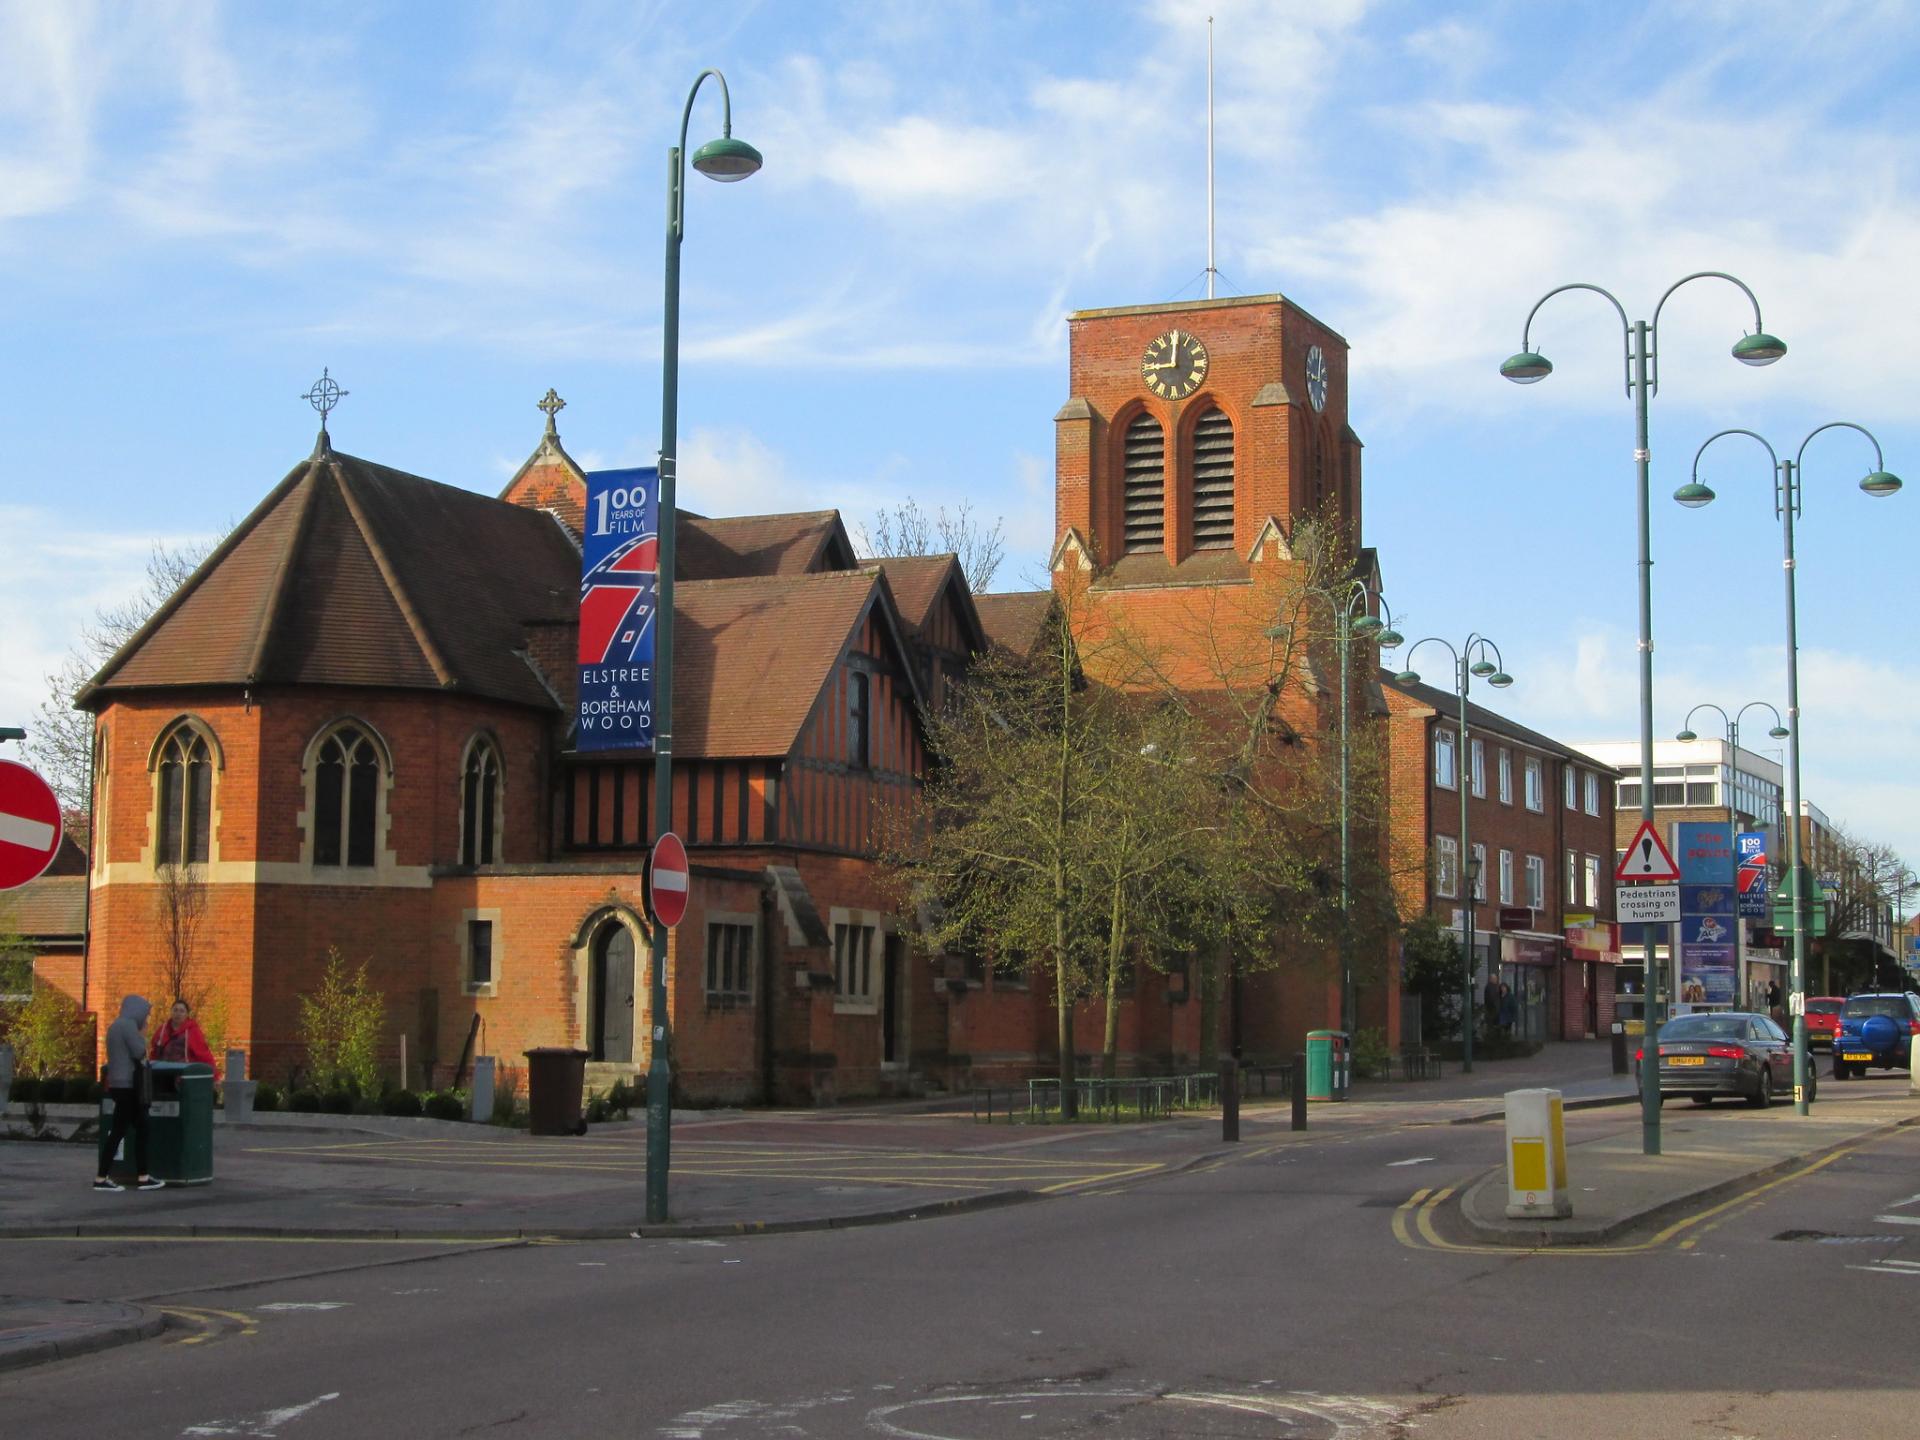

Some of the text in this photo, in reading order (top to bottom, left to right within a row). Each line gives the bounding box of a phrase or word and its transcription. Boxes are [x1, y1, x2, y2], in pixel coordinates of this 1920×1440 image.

[592, 486, 646, 536] 100
[611, 508, 646, 520] YEARS OF
[610, 520, 645, 534] FILM
[583, 668, 650, 684] ELSTREE
[610, 685, 620, 698] &
[582, 699, 651, 715] BOREHAM
[582, 715, 650, 730] WOOD
[1740, 838, 1760, 854] 100
[1620, 890, 1676, 899] Pedestrians
[1620, 900, 1661, 909] crossing
[1632, 910, 1664, 919] humps
